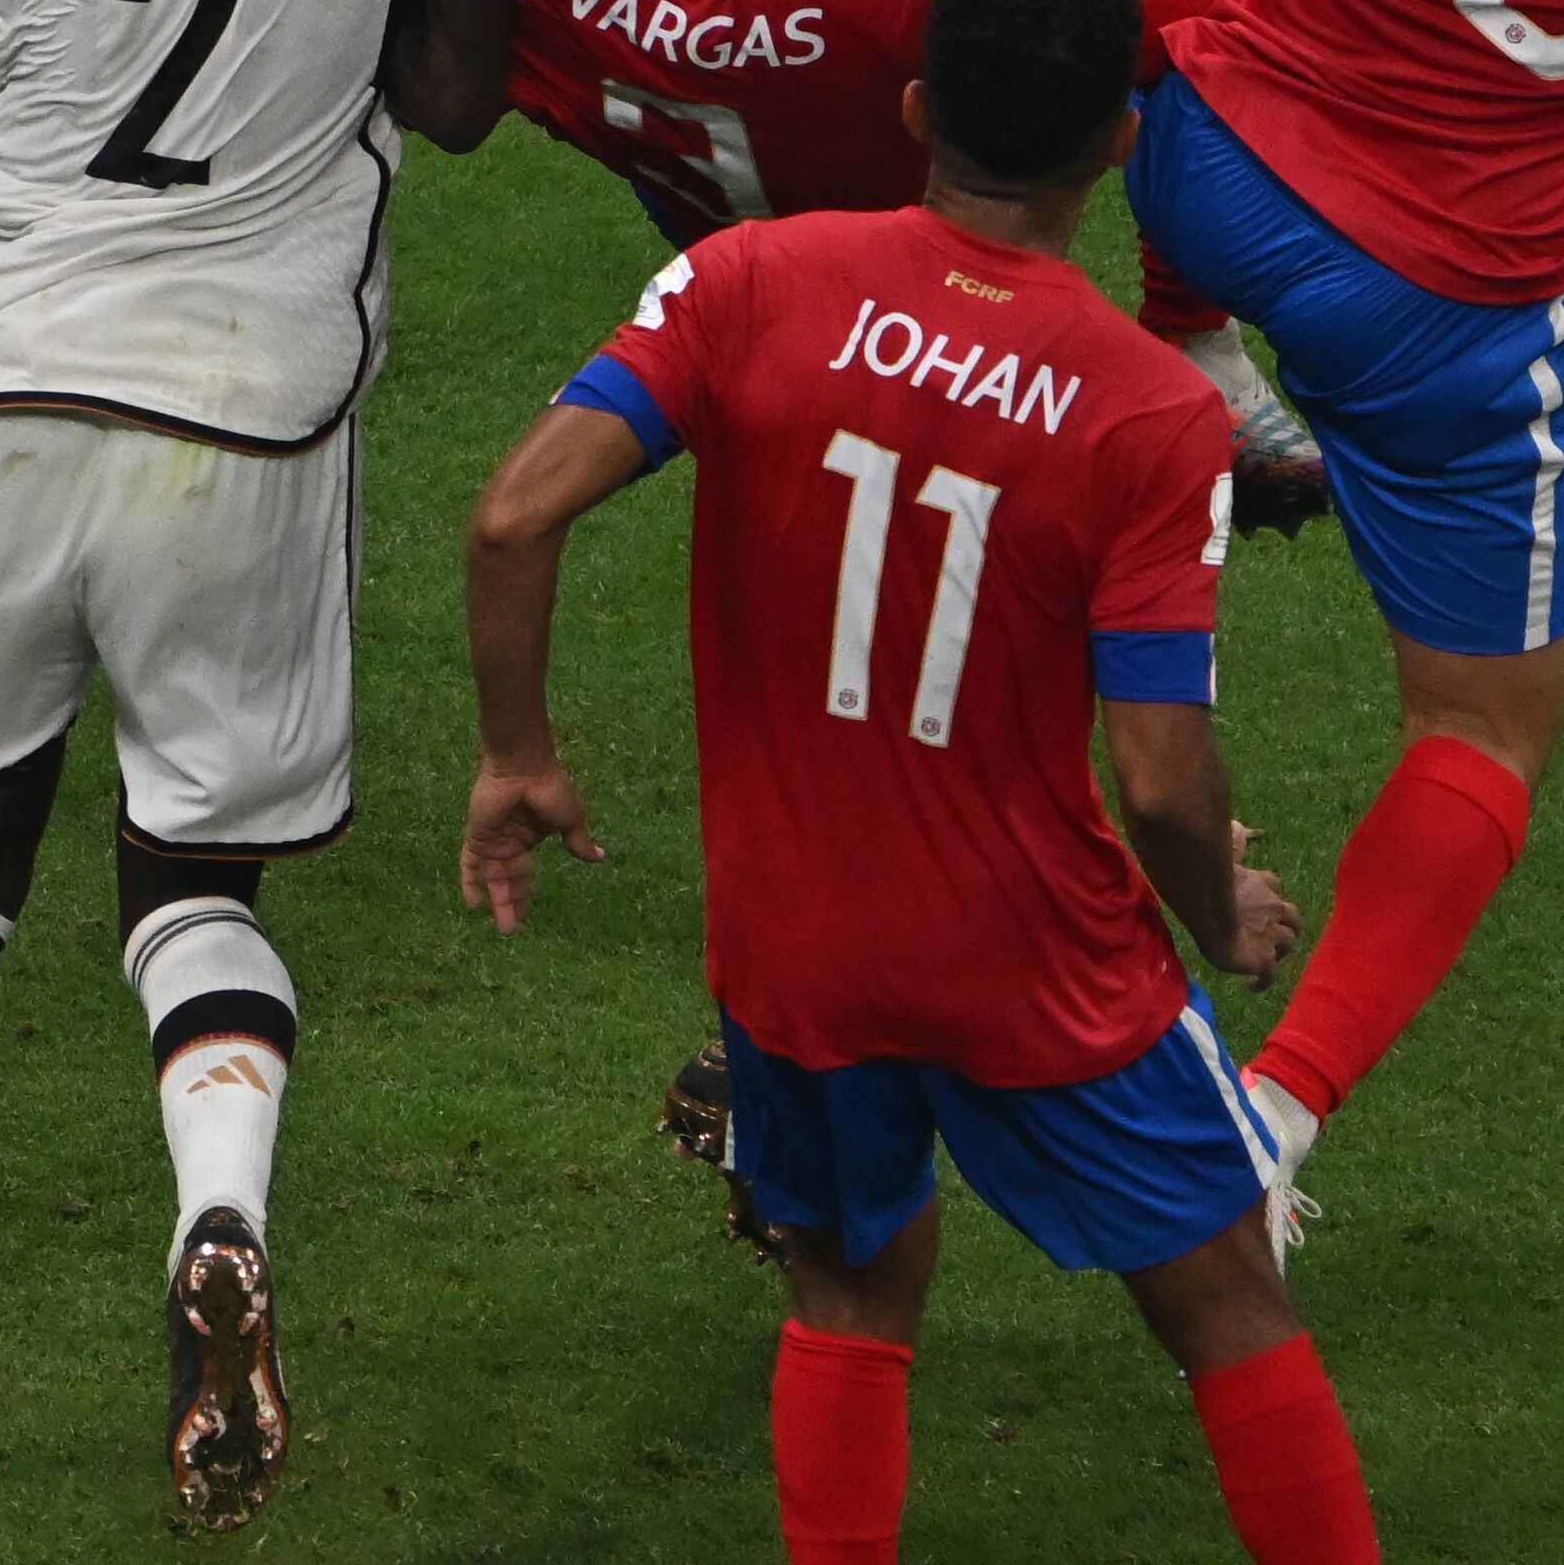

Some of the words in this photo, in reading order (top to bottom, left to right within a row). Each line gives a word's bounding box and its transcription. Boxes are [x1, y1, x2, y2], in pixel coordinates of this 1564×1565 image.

[944, 270, 1015, 304] FCRF
[829, 298, 1082, 435] JOHAN
[822, 428, 1002, 749] 11
